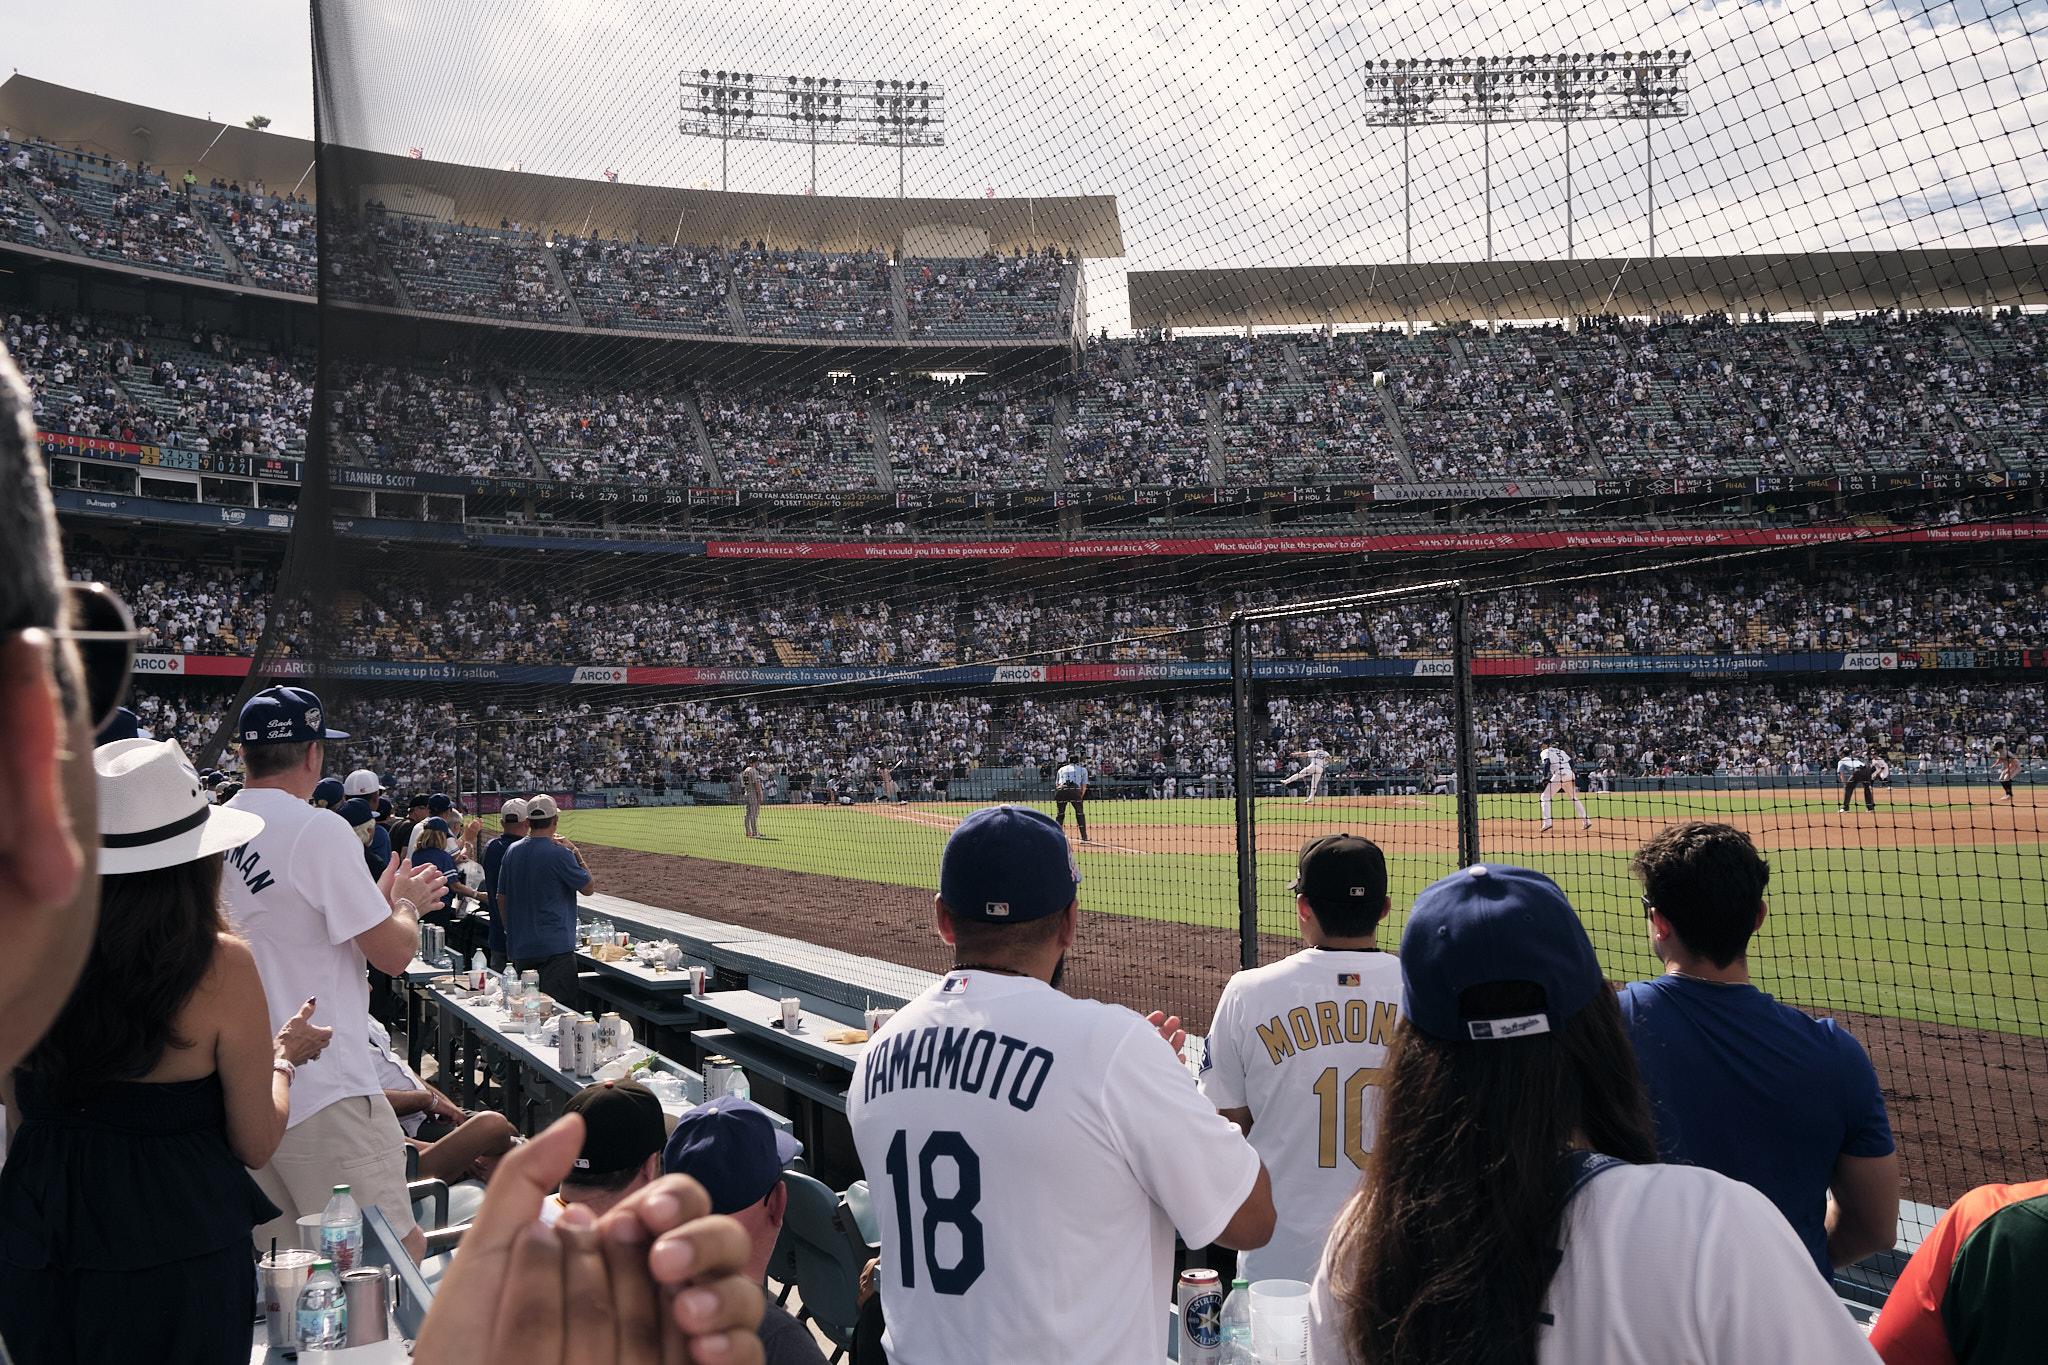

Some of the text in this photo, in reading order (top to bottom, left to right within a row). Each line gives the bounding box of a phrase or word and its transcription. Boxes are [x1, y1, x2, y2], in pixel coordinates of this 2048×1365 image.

[48, 434, 115, 450] 0 0 0 0
[48, 444, 54, 452] 0
[147, 456, 154, 464] 3
[203, 459, 209, 470] 9
[218, 461, 246, 474] 0 2 2
[344, 471, 383, 485] TANNER
[385, 474, 416, 488] SCOTT
[598, 492, 618, 502] 2.79
[632, 494, 648, 503] 1.01
[1396, 489, 1425, 499] BANK
[1445, 488, 1496, 497] AMERICA
[663, 495, 682, 504] .210
[1567, 536, 1589, 544] What
[1617, 536, 1632, 545] you
[1635, 534, 1650, 543] like
[1651, 534, 1665, 543] the
[1667, 535, 1693, 545] power
[1695, 535, 1704, 543] to
[1775, 533, 1799, 541] BANK
[1801, 533, 1811, 541] OF
[1927, 529, 1950, 538] What
[1952, 528, 1978, 538] woud
[1979, 530, 1995, 540] you
[1997, 528, 2012, 537] like
[2015, 528, 2029, 537] the
[1214, 542, 1236, 551] What
[1238, 542, 1262, 551] would
[1264, 543, 1278, 553] you
[1280, 541, 1295, 550] like
[1297, 541, 1311, 550] the
[1339, 541, 1348, 549] to
[1444, 539, 1454, 547] OF
[1456, 538, 1494, 547] AMERICA
[718, 546, 794, 555] BANK OF AMERICA
[1069, 545, 1091, 554] BANK
[1105, 544, 1143, 553] AMERICA
[133, 659, 167, 670] ARCO
[1535, 660, 1557, 671] Join
[1559, 660, 1590, 670] ARCO
[1592, 659, 1640, 669] Rewards
[1642, 659, 1652, 669] to
[1655, 660, 1680, 669] save
[1699, 659, 1709, 668] to
[1849, 657, 1880, 667] ARCO
[259, 662, 282, 674] Join
[371, 666, 382, 675] to
[384, 668, 410, 676] save
[413, 668, 427, 679] up
[430, 668, 440, 677] to
[442, 667, 499, 679] $1/gallon.
[1113, 666, 1135, 677] Join
[1137, 666, 1167, 676] ARCO
[1170, 665, 1216, 676] Rewards
[1258, 666, 1272, 677] up
[1274, 665, 1285, 674] to
[1287, 664, 1342, 676] $1/gallon.
[1421, 663, 1451, 673] ARCO
[580, 671, 611, 681] ARCO
[694, 670, 716, 680] Join
[719, 670, 749, 680] ARCO
[751, 670, 797, 681] Rewards
[813, 671, 838, 681] save
[1000, 669, 1030, 679] ARCO
[266, 718, 293, 728] Back
[266, 730, 294, 739] Back
[864, 1025, 1054, 1112] YAMAMOTO
[1313, 1066, 1388, 1171] 10
[885, 1129, 985, 1296] 18
